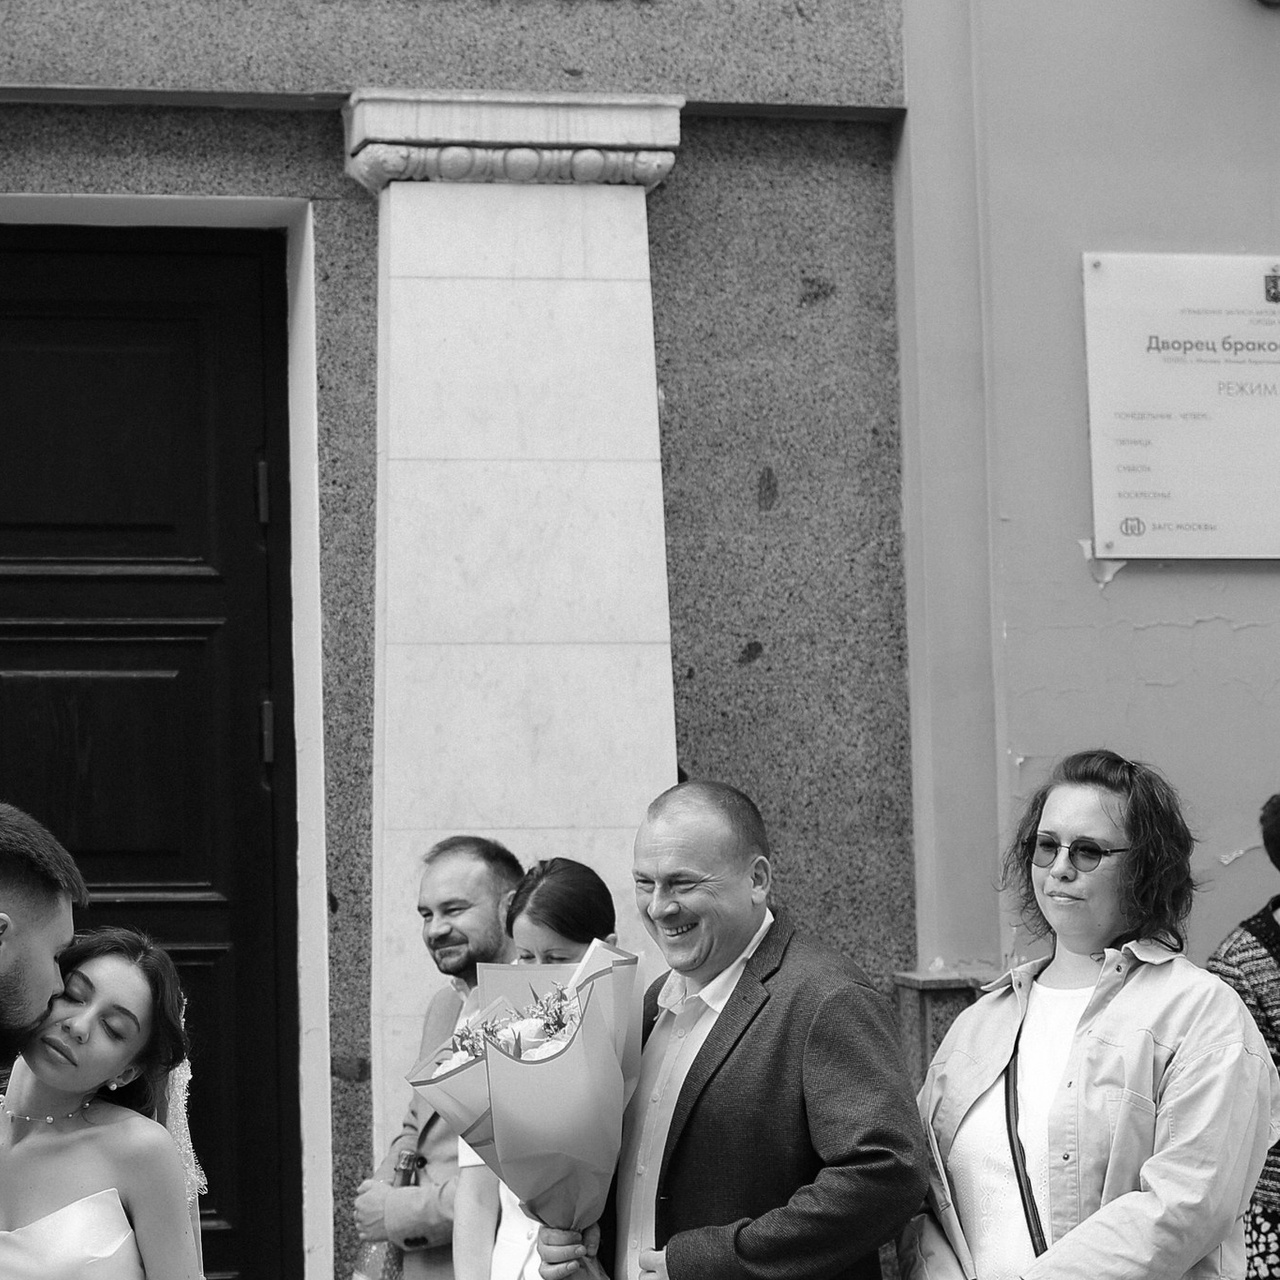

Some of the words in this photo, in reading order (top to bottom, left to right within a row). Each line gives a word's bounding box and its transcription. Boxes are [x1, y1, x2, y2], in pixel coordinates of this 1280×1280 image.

[1147, 335, 1217, 355] Дворец
[1222, 335, 1280, 356] брако
[1218, 382, 1278, 397] РЕЖИМ
